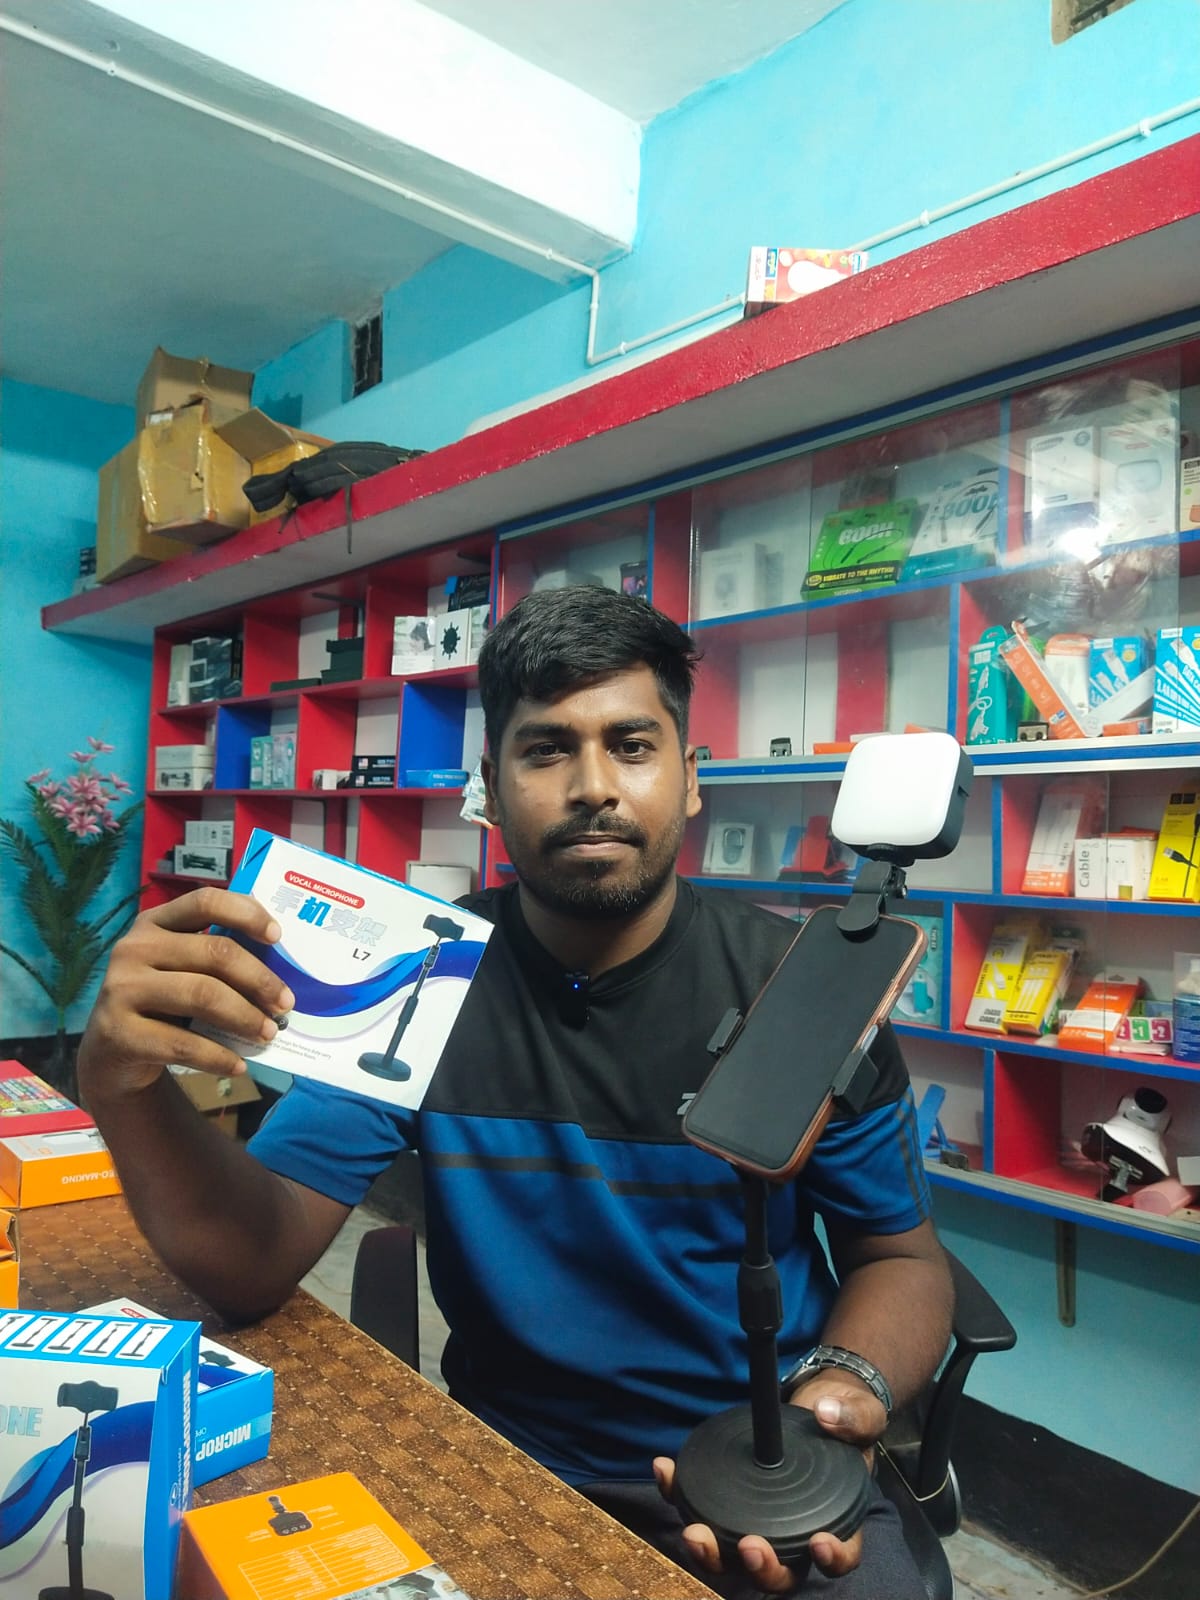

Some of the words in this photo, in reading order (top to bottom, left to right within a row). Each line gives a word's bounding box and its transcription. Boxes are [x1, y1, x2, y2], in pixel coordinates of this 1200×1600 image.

[856, 569, 868, 577] THE
[1079, 850, 1089, 888] Cable
[289, 873, 312, 888] VOCAL
[313, 883, 360, 906] MICROPHONE
[270, 884, 388, 947] 手机支架
[352, 947, 372, 961] L7
[195, 1422, 251, 1462] MICROP
